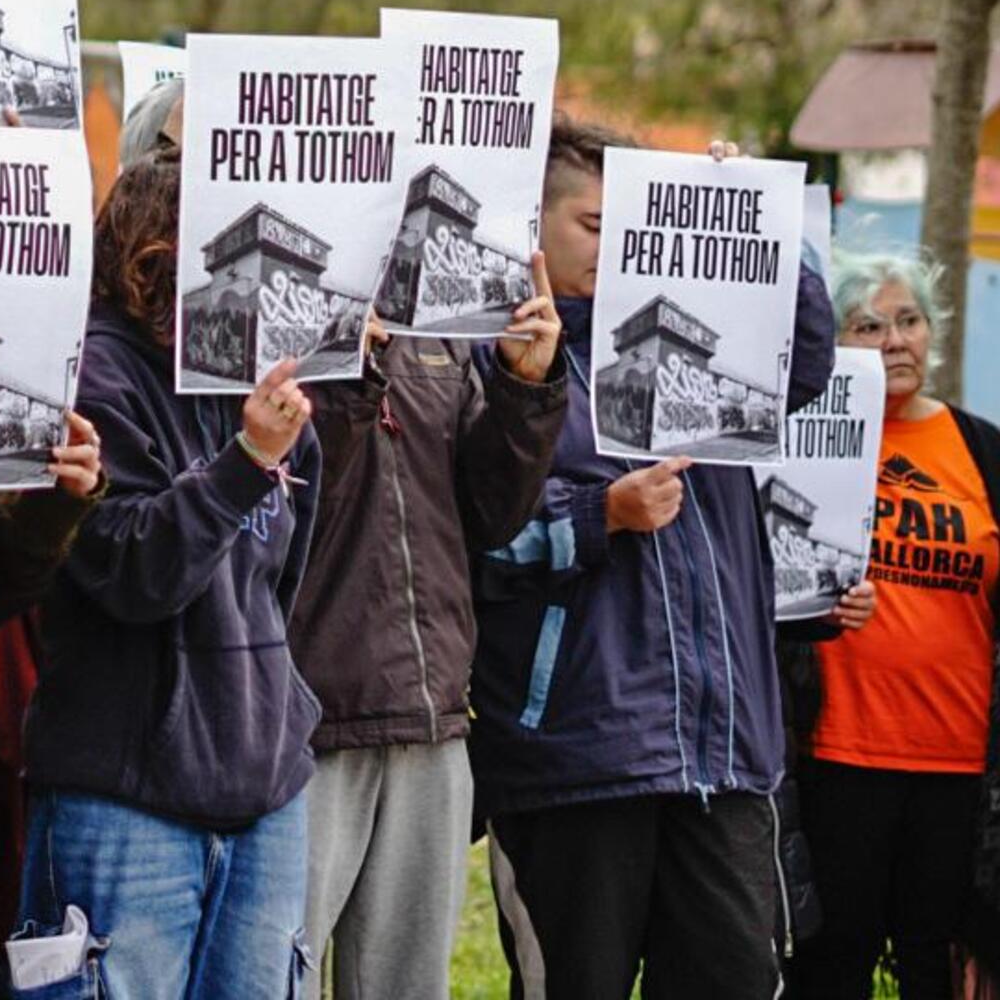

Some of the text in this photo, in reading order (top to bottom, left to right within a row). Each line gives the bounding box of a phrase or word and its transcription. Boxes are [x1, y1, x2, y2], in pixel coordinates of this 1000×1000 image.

[420, 44, 524, 98] HABITATGE
[238, 71, 377, 127] HABITATGE
[440, 98, 454, 146] A
[461, 98, 535, 149] TOTHOM
[210, 128, 395, 184] PER A TOTHOM
[646, 181, 764, 235] HABITATGE
[620, 229, 780, 285] PER A TOTHOM
[795, 418, 866, 458] TOTHOM
[872, 497, 967, 545] PAH
[870, 538, 984, 581] ALLORCA
